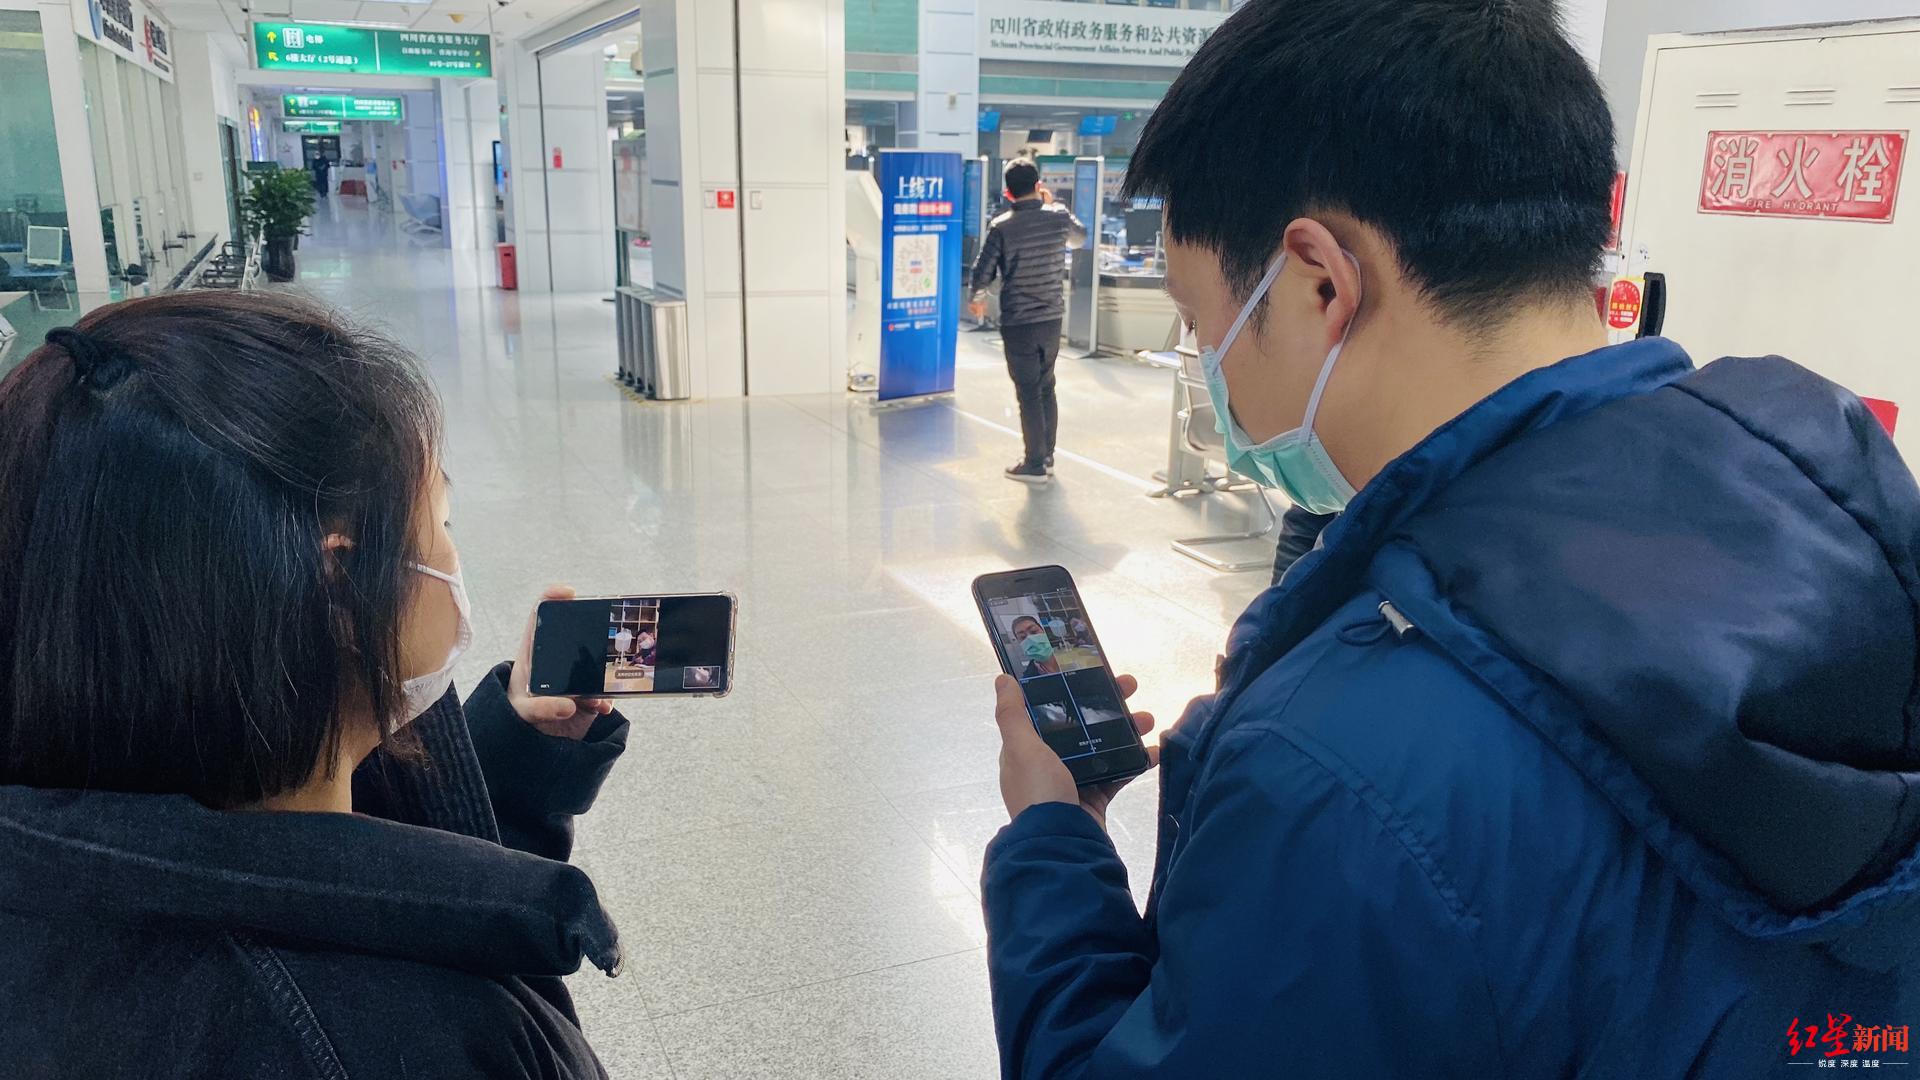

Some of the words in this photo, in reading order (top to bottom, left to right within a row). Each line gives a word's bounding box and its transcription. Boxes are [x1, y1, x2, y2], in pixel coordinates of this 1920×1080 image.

[1710, 136, 1891, 203] 消火栓
[1746, 198, 1773, 209] FIRE
[1783, 201, 1840, 212] HYDRANT
